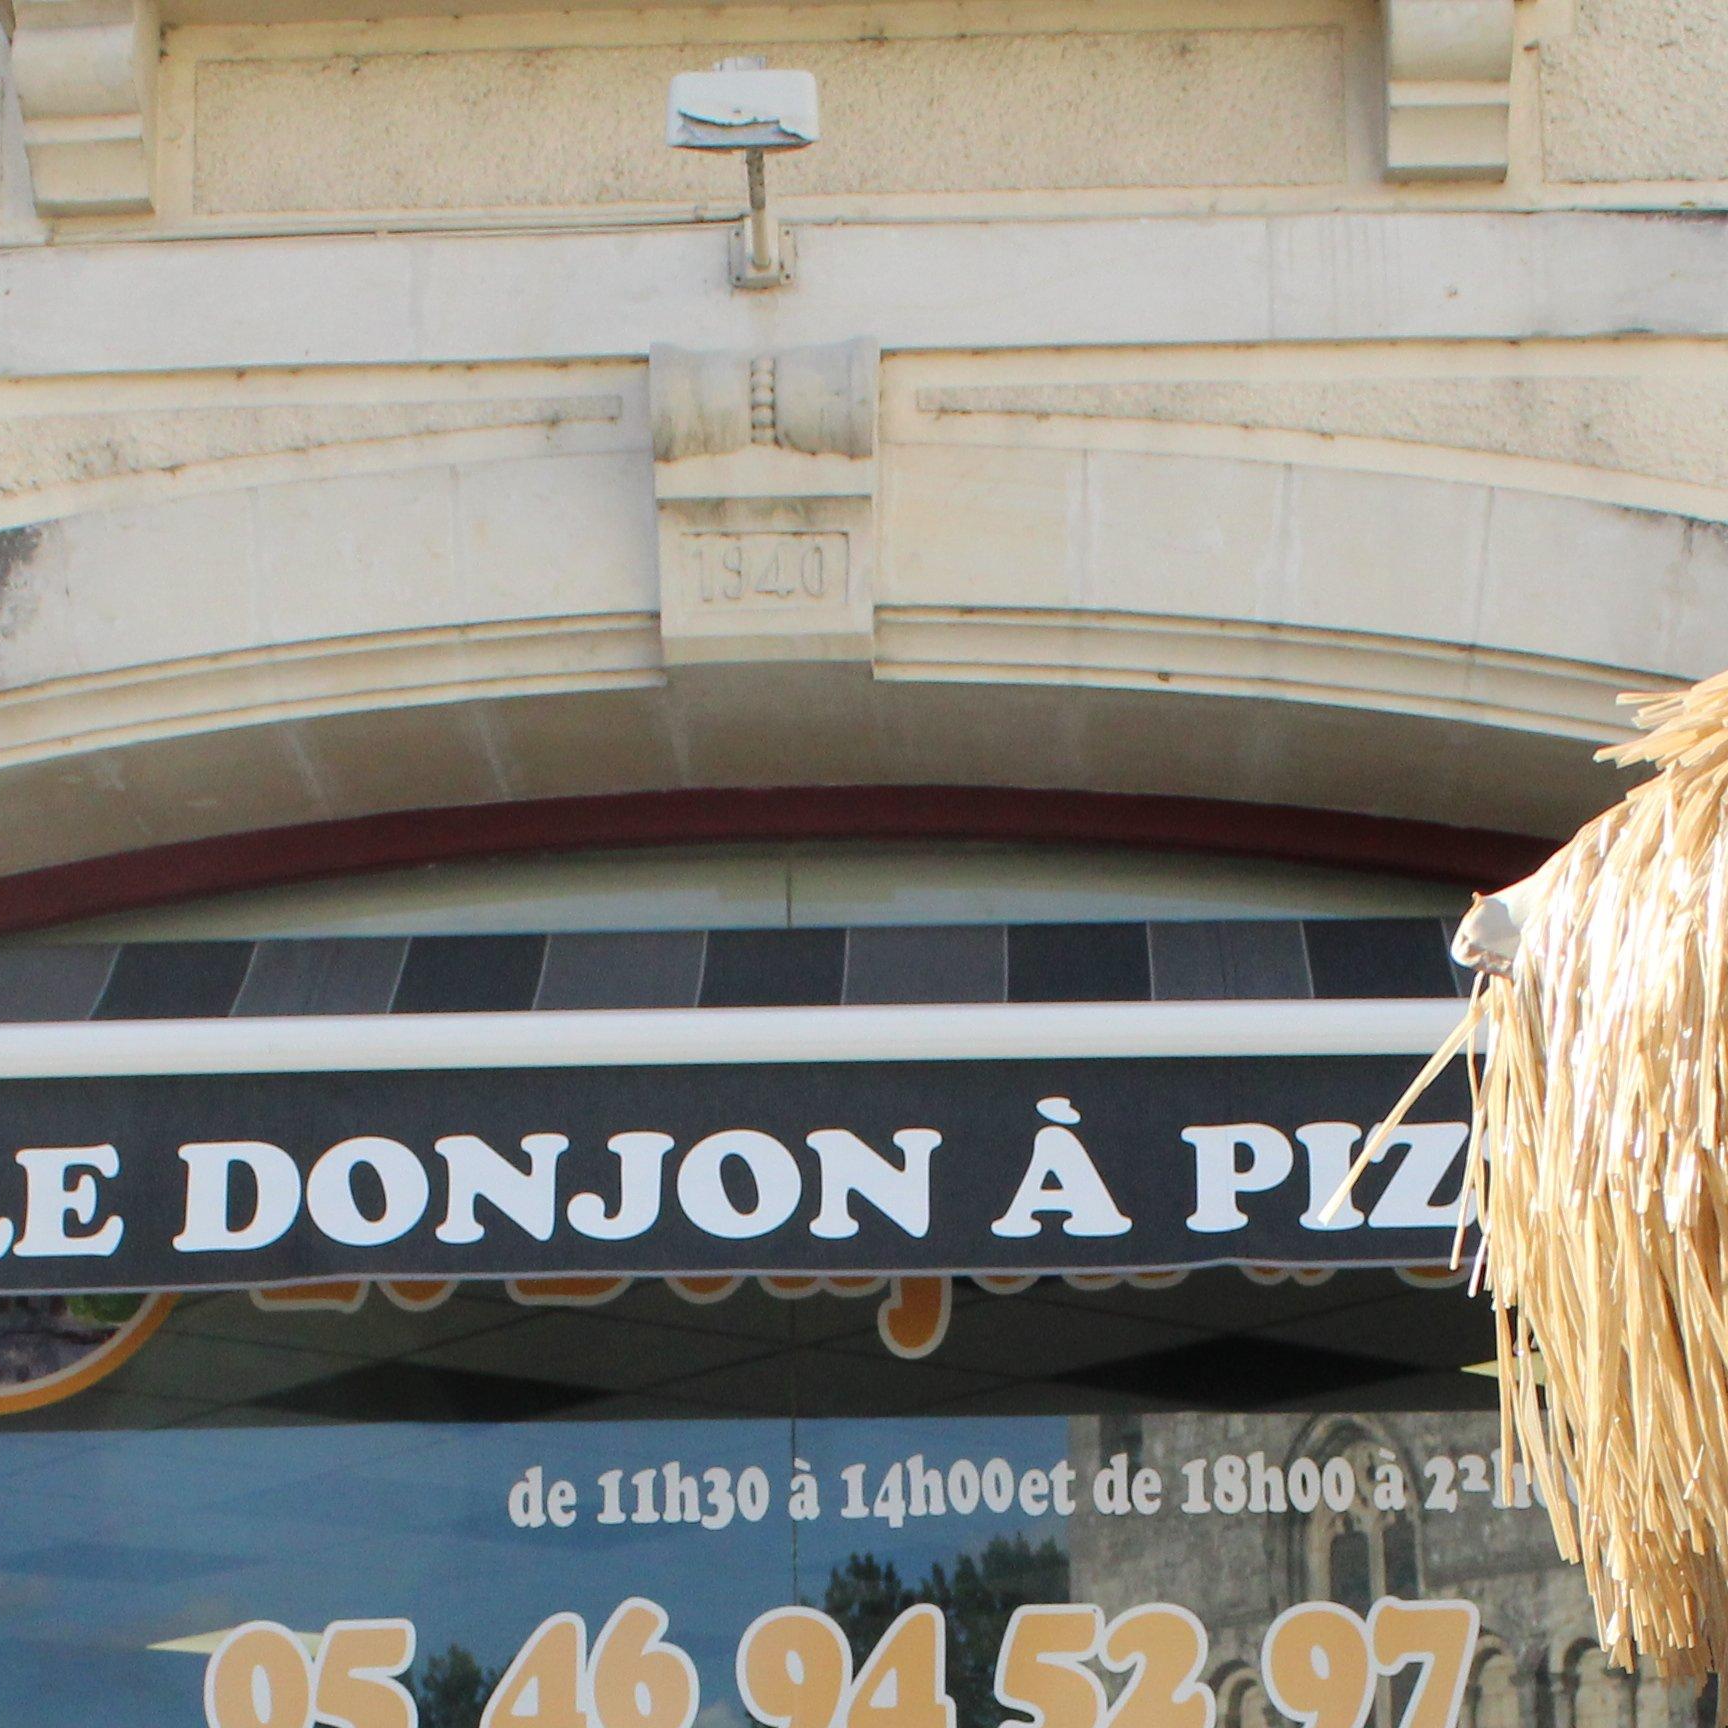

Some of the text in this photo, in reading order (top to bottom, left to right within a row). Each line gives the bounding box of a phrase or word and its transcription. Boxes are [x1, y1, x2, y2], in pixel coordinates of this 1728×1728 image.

[171, 1128, 942, 1252] DONJON
[991, 1097, 1133, 1237] À
[1180, 1121, 1493, 1236] PIZ
[508, 1466, 577, 1528] de
[597, 1461, 770, 1530] 11h30
[788, 1458, 821, 1521] à
[1092, 1453, 1162, 1516] de
[1180, 1451, 1356, 1515] 18h00
[1373, 1448, 1407, 1512] à
